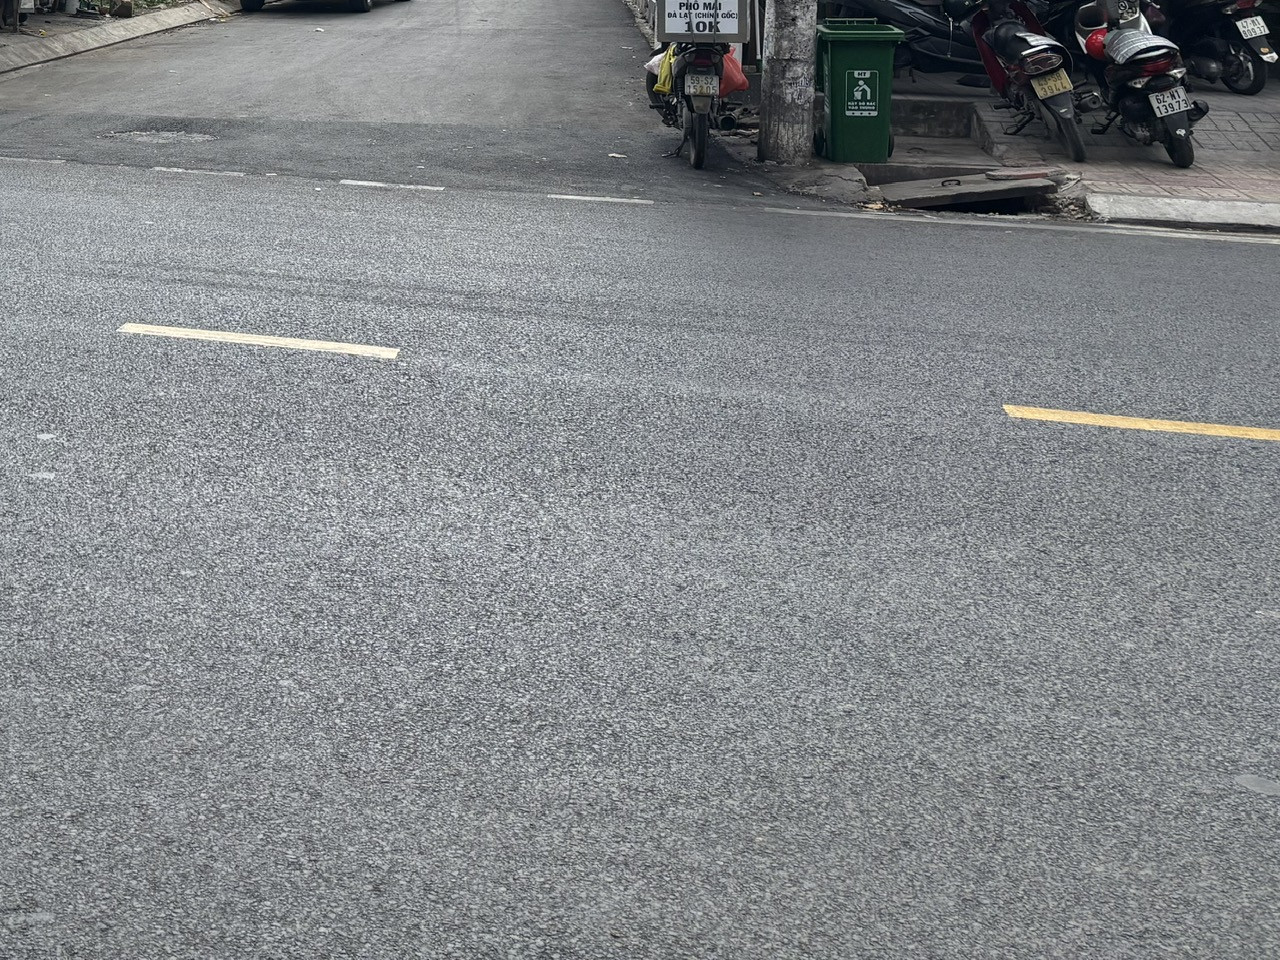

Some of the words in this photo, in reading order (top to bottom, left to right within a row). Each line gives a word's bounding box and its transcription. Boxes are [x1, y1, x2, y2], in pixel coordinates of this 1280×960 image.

[685, 21, 721, 33] 10K
[690, 76, 713, 85] 59-S2
[1156, 98, 1189, 115] 139.73
